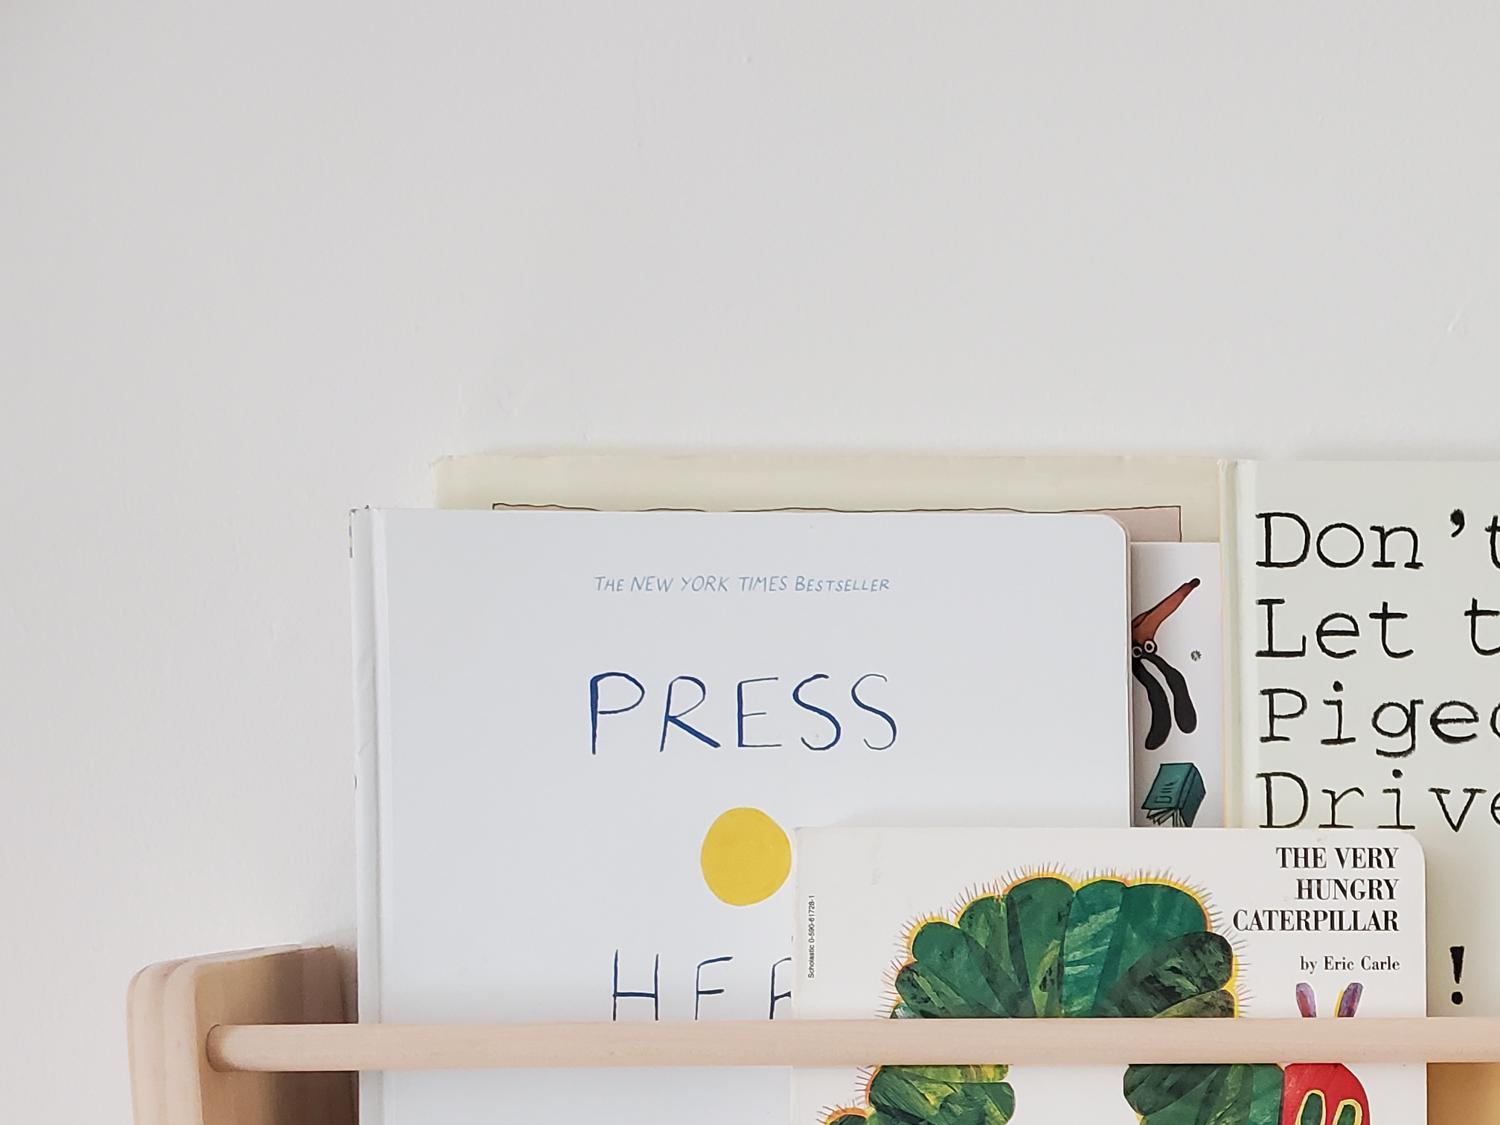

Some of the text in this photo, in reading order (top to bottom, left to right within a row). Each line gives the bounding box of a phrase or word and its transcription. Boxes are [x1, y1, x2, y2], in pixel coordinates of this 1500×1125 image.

[595, 576, 624, 592] THE
[630, 576, 674, 592] NEW
[680, 576, 730, 592] YORK
[738, 576, 788, 592] TIMES
[1255, 598, 1414, 659] Let
[590, 671, 897, 755] PRESS
[1276, 847, 1399, 869] THE VERY
[1295, 878, 1399, 900] HUNGRY
[1233, 909, 1399, 932] CATERPILLAR
[1300, 955, 1400, 974] by Eric Carle
